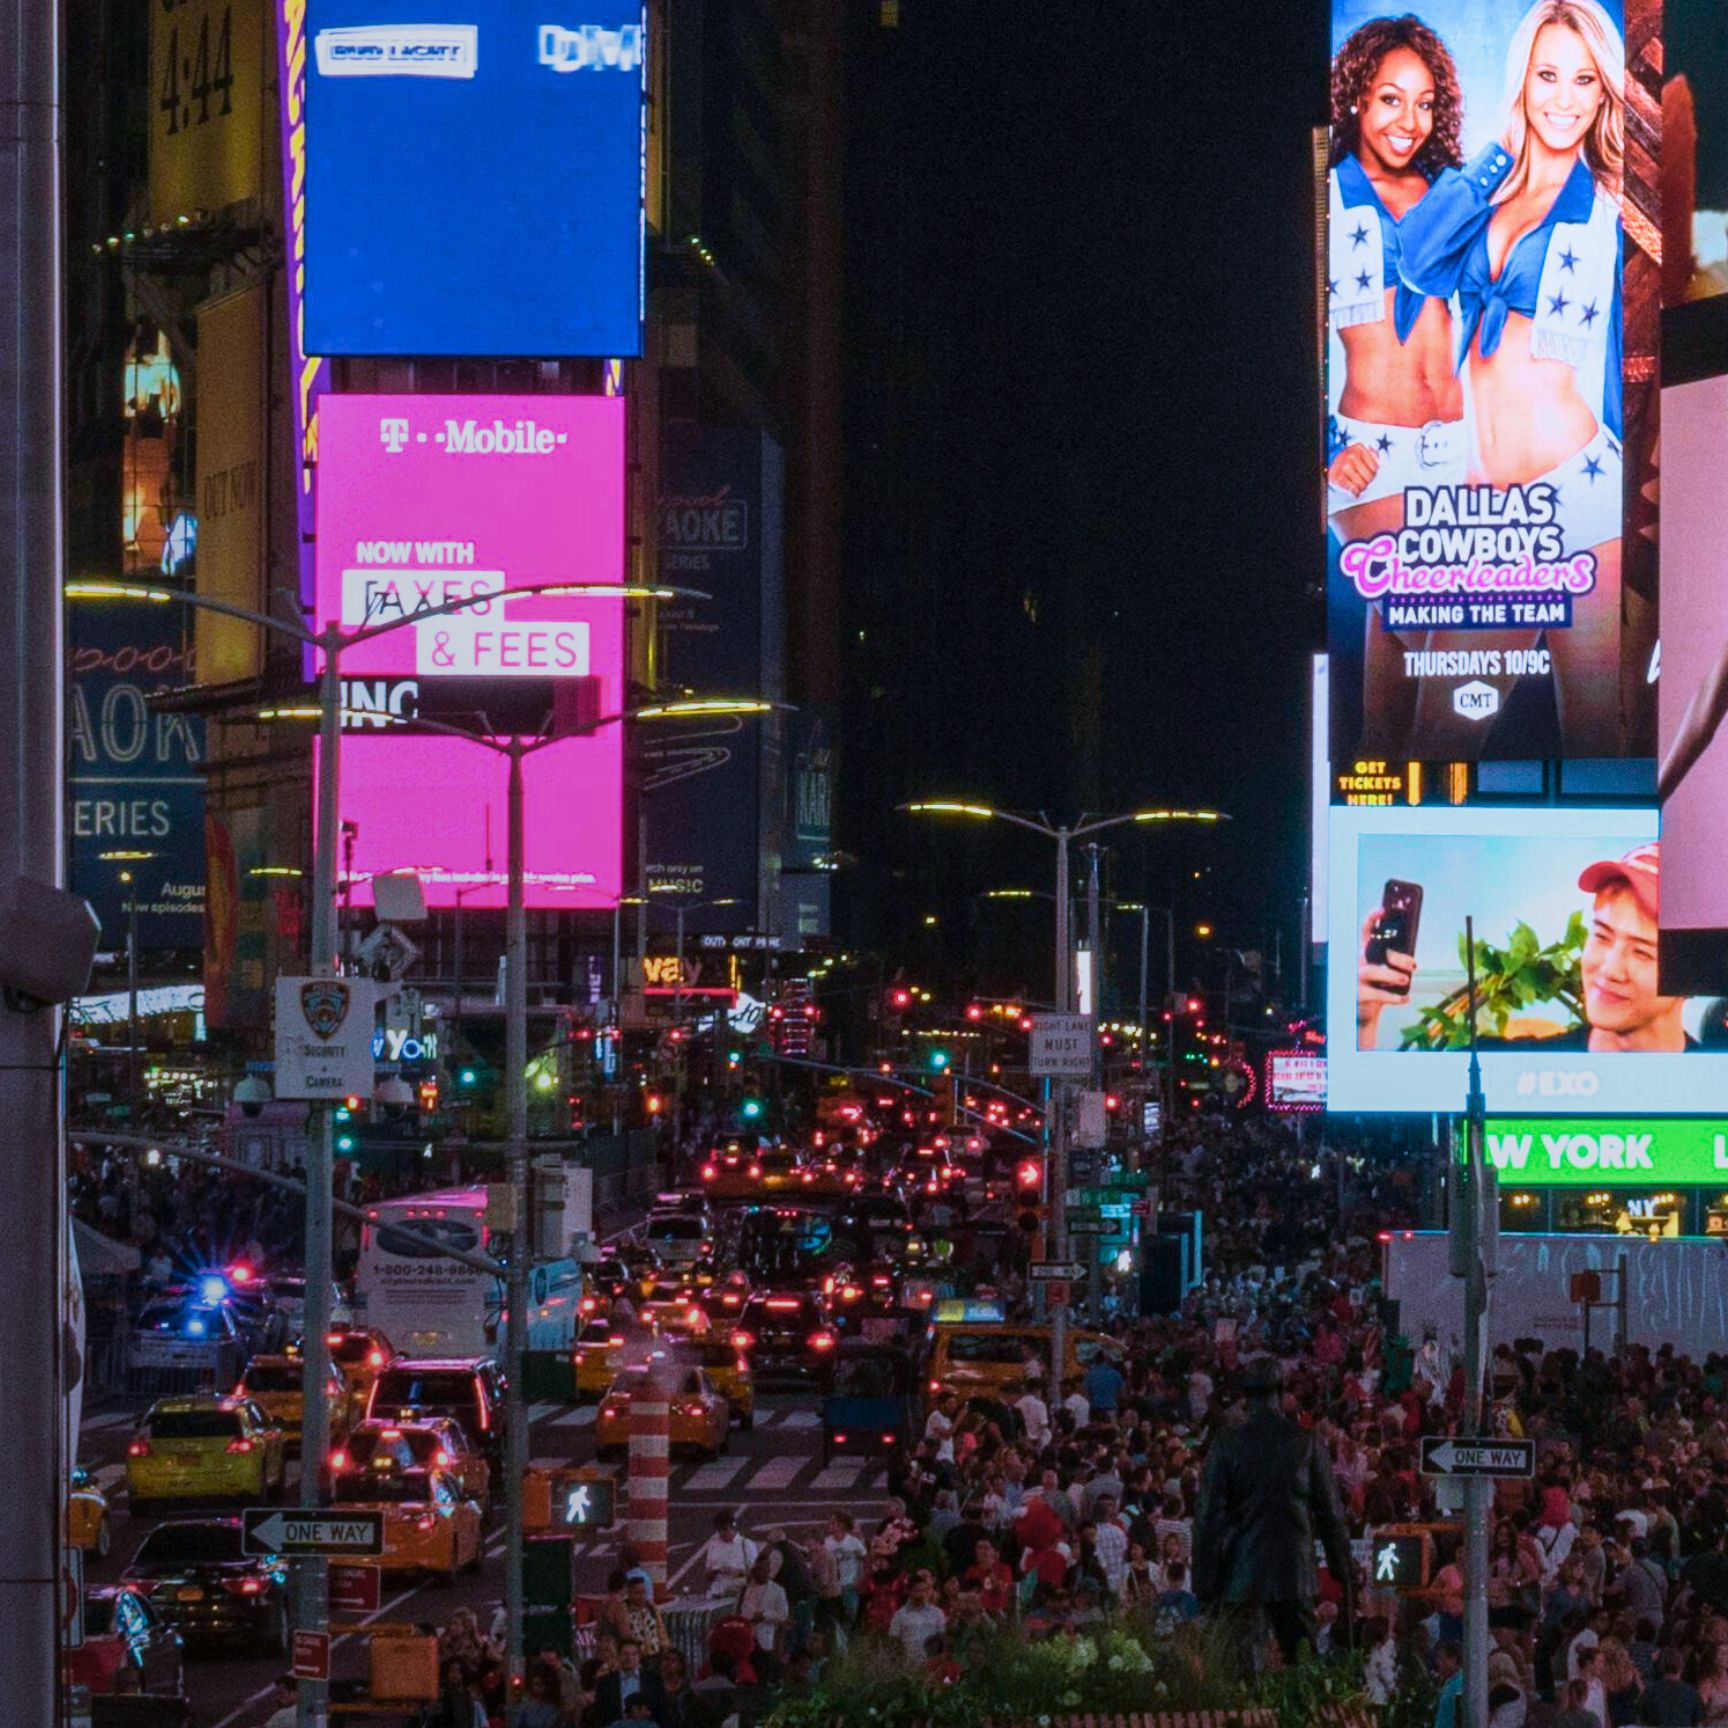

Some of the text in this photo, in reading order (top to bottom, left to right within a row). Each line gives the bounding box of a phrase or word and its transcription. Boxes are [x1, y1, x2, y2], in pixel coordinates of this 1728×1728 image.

[1406, 485, 1556, 527] DALLAS
[357, 541, 475, 563] NOW WITH
[1397, 525, 1563, 564] COWBOYS
[1342, 535, 1594, 595] Cheerleaders
[1388, 603, 1566, 625] MAKING THE TEAM
[431, 631, 577, 668] & FEES
[1403, 648, 1551, 678] THURSDAYS 10/9C
[1459, 692, 1493, 708] CMT
[1354, 761, 1387, 774] GET
[1339, 776, 1402, 790] TICKETS
[1542, 1134, 1653, 1171] YORK
[1453, 1448, 1523, 1467] ONE WAY
[285, 1523, 368, 1541] ONE WAY
